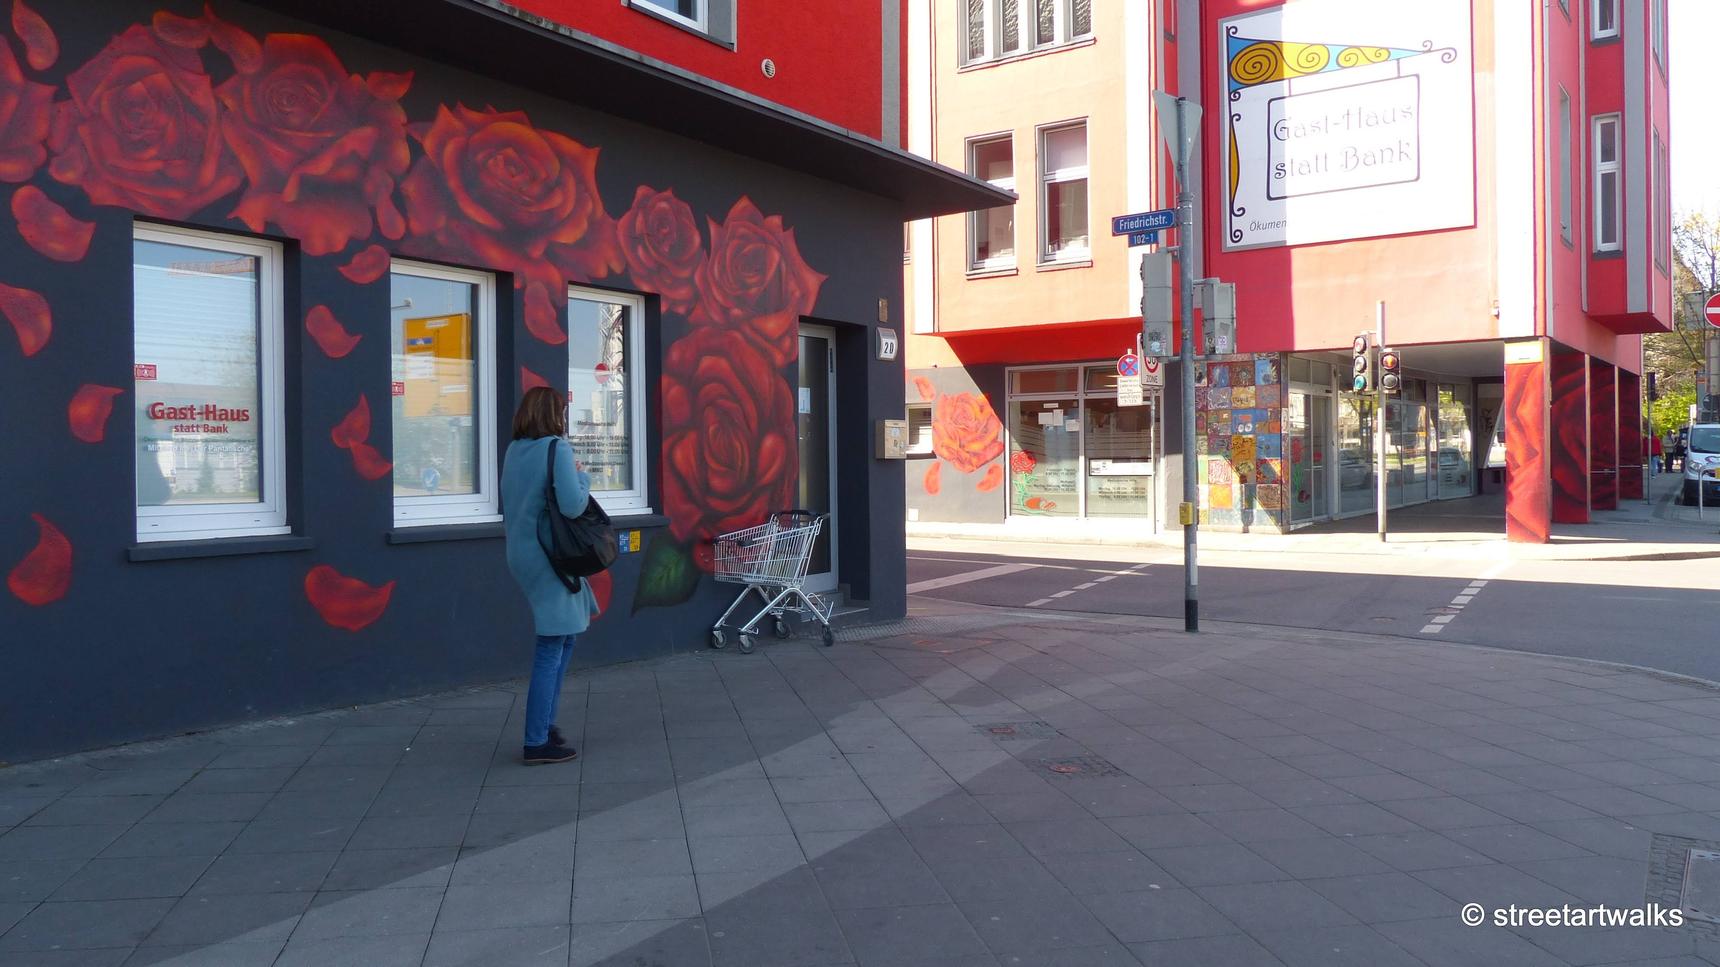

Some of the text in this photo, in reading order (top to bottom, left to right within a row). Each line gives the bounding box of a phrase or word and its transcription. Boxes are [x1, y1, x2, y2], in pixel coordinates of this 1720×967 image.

[1274, 105, 1413, 141] Gast-Haus
[1340, 140, 1412, 171] Bank
[1119, 214, 1168, 230] Friedrichstr.
[1134, 233, 1154, 244] 102-1
[883, 341, 894, 354] 20
[1146, 375, 1158, 383] ZONE
[150, 402, 250, 421] Gast-Haus
[173, 424, 229, 433] statt Bank
